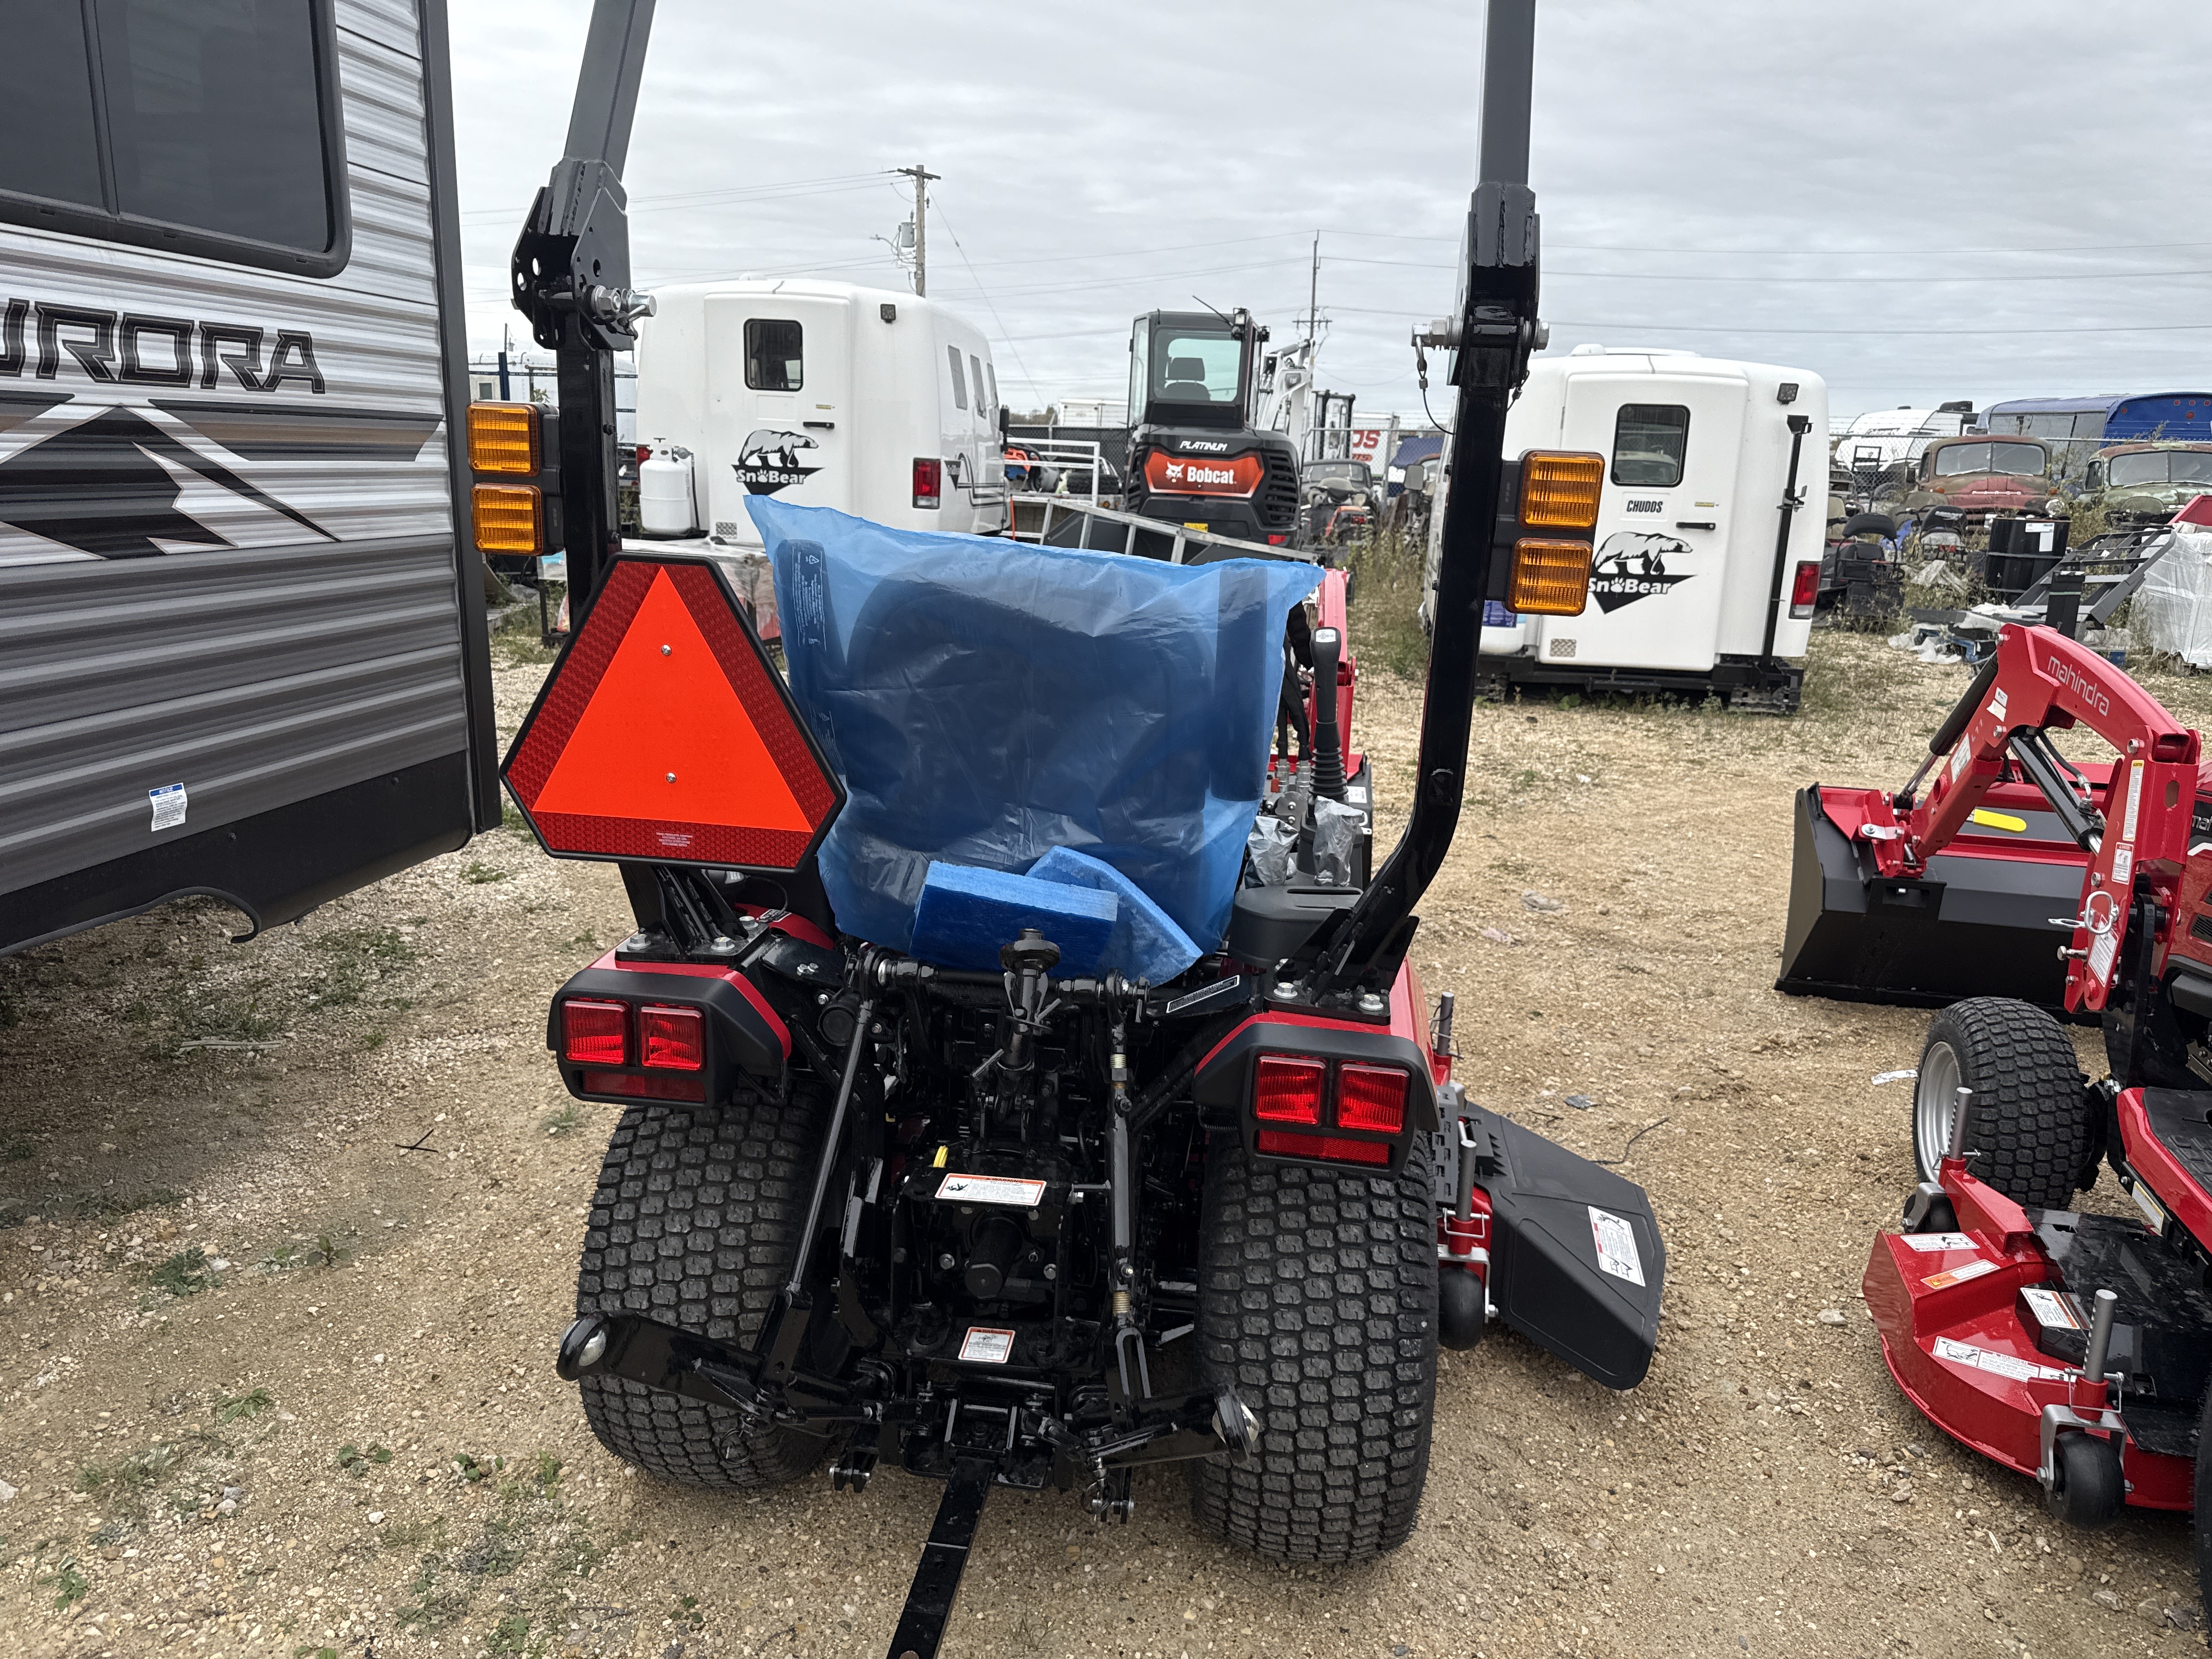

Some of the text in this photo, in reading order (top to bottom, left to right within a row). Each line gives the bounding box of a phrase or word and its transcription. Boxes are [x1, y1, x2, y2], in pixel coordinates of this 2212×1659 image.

[1180, 441, 1228, 452] PLATINUM
[1187, 466, 1234, 484] Bobcat
[1626, 500, 1663, 513] CHUDDS
[2047, 655, 2109, 717] mahindra
